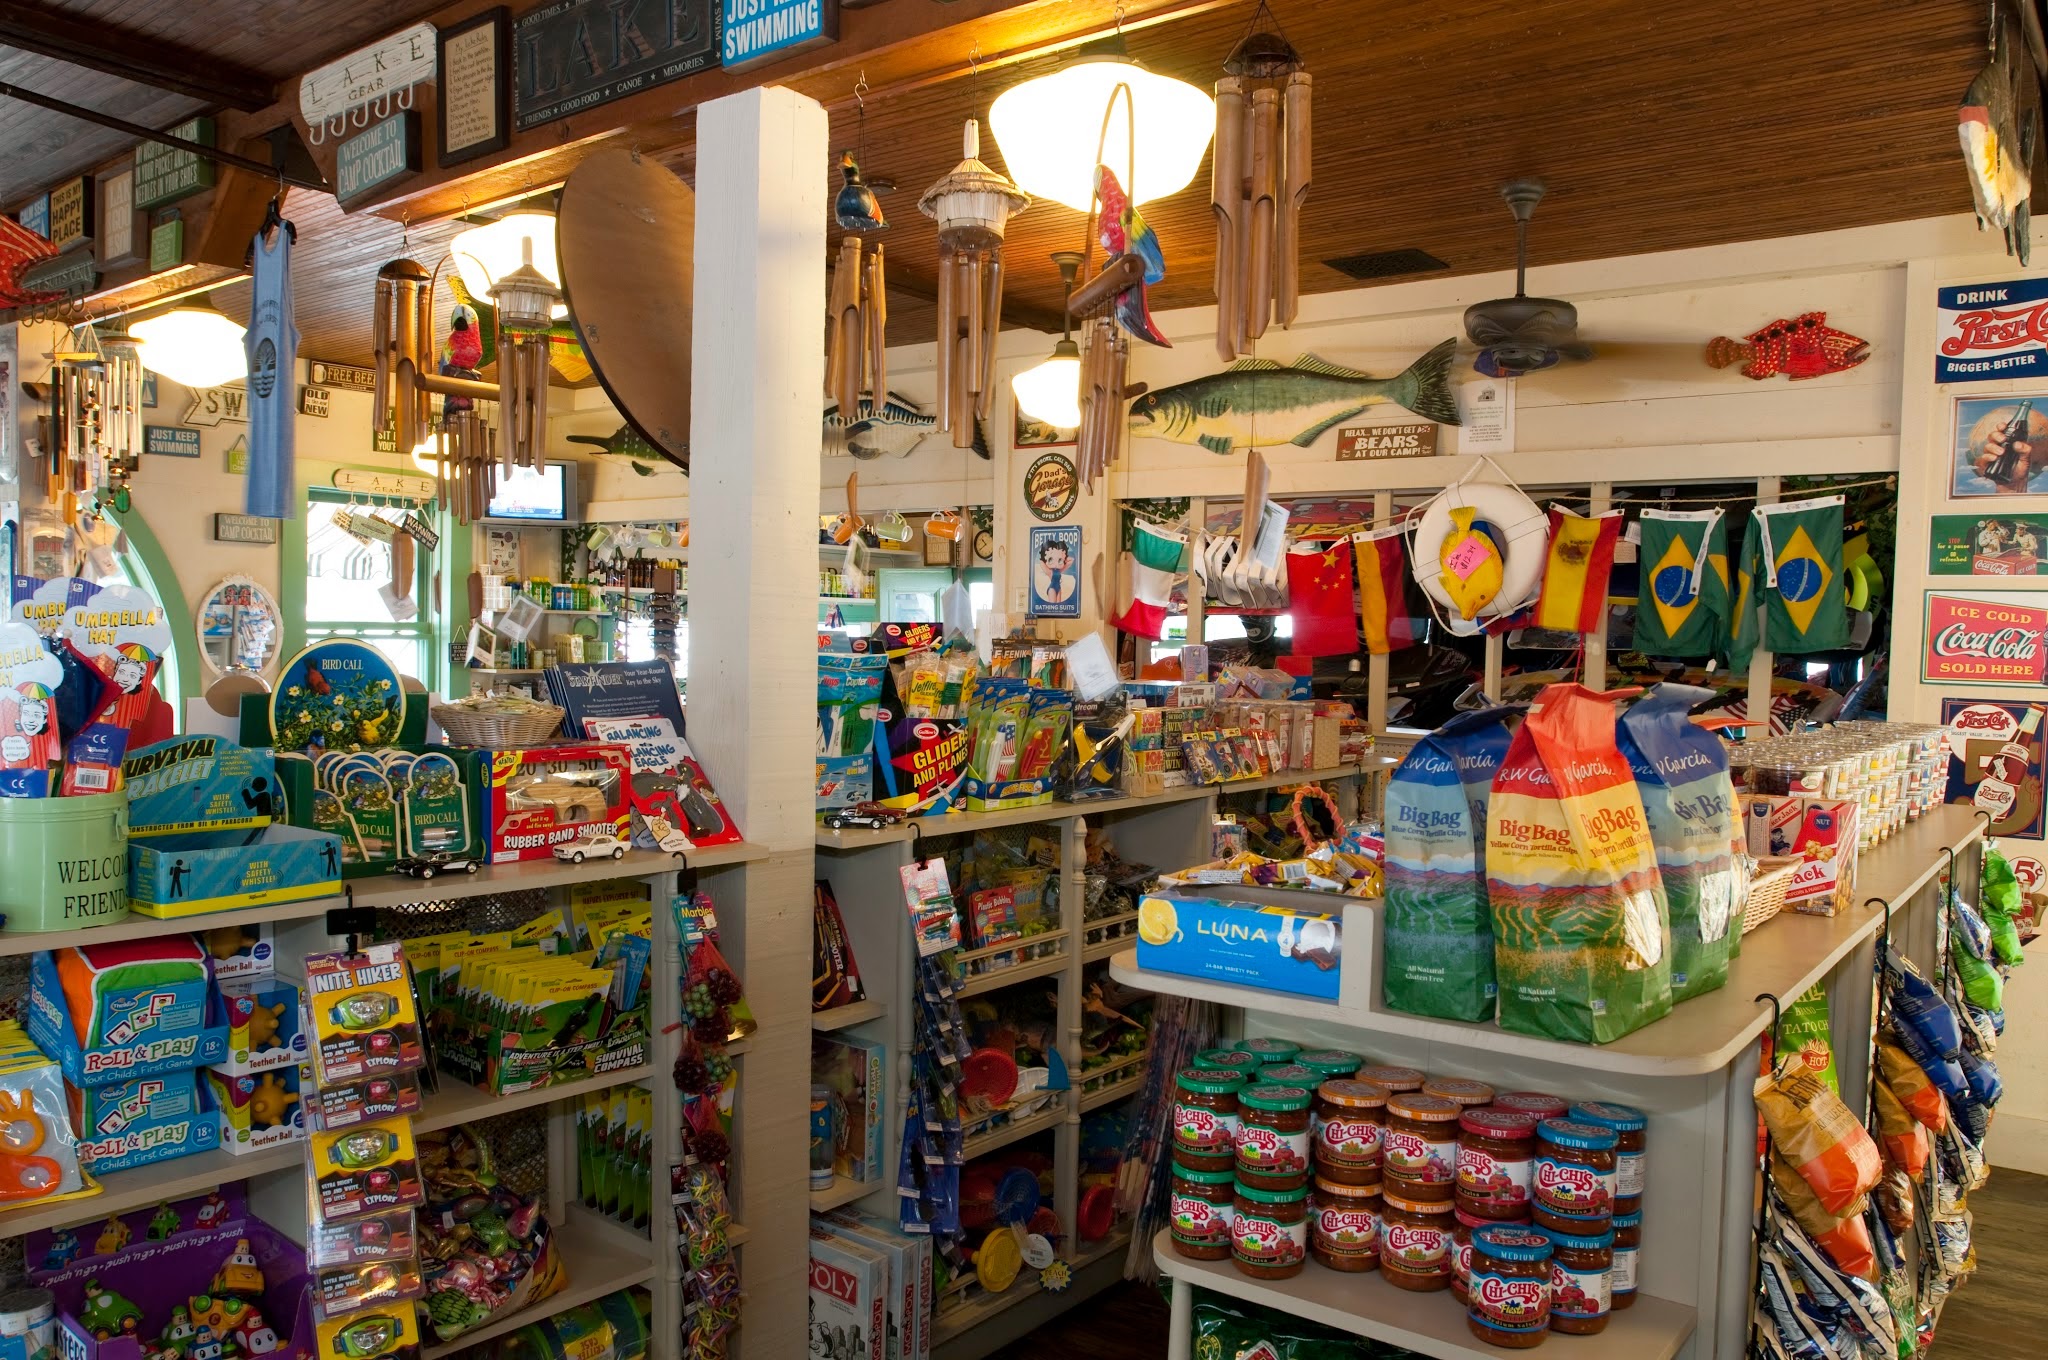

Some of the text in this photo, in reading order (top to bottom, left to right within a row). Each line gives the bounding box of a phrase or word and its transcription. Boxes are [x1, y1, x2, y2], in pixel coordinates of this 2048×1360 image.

[726, 0, 819, 59] SWIMMING
[617, 56, 704, 94] CANOE MEMORIES
[348, 78, 384, 101] GEAR
[525, 91, 600, 125] FRIENDS GOOD FOOD
[343, 120, 397, 162] WELCOME TO
[339, 140, 404, 195] CAMP COCKTAIL
[52, 197, 82, 226] HAPPY
[53, 217, 81, 243] PLACE
[1956, 289, 2008, 305] DRINK
[1947, 355, 2036, 373] BIGGER-BETTER
[306, 389, 328, 401] OLD
[305, 403, 327, 416] NEW
[151, 429, 197, 443] JUST KEEP
[1355, 435, 1419, 450] BEARS
[150, 440, 199, 455] SWIMMING
[1355, 450, 1366, 458] AT
[1369, 449, 1388, 457] OUR
[1391, 448, 1421, 456] CAMP!
[1044, 468, 1066, 479] Dad's
[225, 516, 270, 527] WELCOME TO
[219, 526, 274, 541] CAMP COCKTAIL
[1034, 532, 1078, 549] BETTY BOOP
[1974, 560, 2009, 575] Coca-Cola
[75, 607, 156, 628] UMBRELLA
[1950, 606, 2032, 624] ICE COLD
[88, 629, 117, 645] HAT
[904, 624, 931, 638] GLIDERS
[1935, 622, 2042, 660] Coca-Cola
[322, 659, 364, 670] BIRD CALL
[1939, 662, 2034, 675] SOLD HERE
[911, 679, 937, 695] Jetfire
[607, 726, 663, 741] BALANCING
[913, 728, 968, 769] GLIDERS
[127, 739, 216, 778] URVIVAL
[497, 755, 516, 767] NEATO!
[635, 756, 669, 769] EAGLE
[517, 759, 598, 776] 20 30 50
[913, 747, 968, 788] AND PLANES
[12, 779, 25, 789] CE
[127, 760, 215, 800] RACELET
[206, 807, 237, 815] WHISTLE!
[210, 800, 232, 808] SAFETY
[414, 812, 459, 827] BIRD CALL
[1399, 805, 1461, 828] Big Bag
[1580, 805, 1640, 843] Big Bag
[504, 822, 619, 850] RUBBER BAND SHOOTER
[1408, 828, 1424, 836] Corn
[1425, 829, 1447, 837] Tortilla
[1500, 819, 1571, 845] Big Bag
[1490, 840, 1509, 848] Yellow
[1530, 844, 1557, 852] Tortilla
[1558, 846, 1578, 855] Chips
[246, 867, 272, 877] SAFETY
[249, 861, 269, 869] WITH
[242, 875, 278, 886] WHISTLE!
[978, 896, 1012, 911] Plastic Bubbles
[1198, 919, 1268, 944] LUNA
[411, 951, 434, 959] CLIP-ON
[474, 946, 499, 956] COMPASS
[214, 960, 253, 973] eether Ball
[1206, 963, 1224, 971] 24-BAR
[1225, 966, 1246, 974] VARIETY
[1407, 965, 1416, 973] All
[315, 962, 403, 993] NITE HIKER
[1405, 973, 1445, 983] Gluten Free
[549, 983, 598, 994] CLIP-ON COMPASS
[1518, 987, 1556, 996] All Natural
[205, 1041, 221, 1050] 18+
[249, 1053, 291, 1069] Teether Ball
[595, 1043, 643, 1064] SURVIVAL
[365, 1057, 399, 1068] EXPLORE
[594, 1053, 643, 1073] COMPASS
[1809, 1057, 1827, 1066] HOT
[83, 1059, 193, 1084] Your Child's First Game
[364, 1104, 397, 1115] EXPLORE
[197, 1128, 212, 1137] 18+
[1326, 1122, 1377, 1144] CHI-CHI'S
[1491, 1130, 1507, 1138] HOT
[1616, 1123, 1643, 1131] MEDIUM
[251, 1130, 293, 1147] Teether Ball
[1555, 1136, 1588, 1148] MEDIUM
[101, 1145, 186, 1171] Child's First Game
[1186, 1174, 1204, 1182] MILD
[1460, 1172, 1476, 1184] Fiesta
[1539, 1163, 1593, 1191] CHI-CHI'S
[364, 1195, 398, 1206] EXPLORE
[1552, 1188, 1577, 1201] Fiesta
[1539, 1199, 1564, 1214] Medium
[1233, 1214, 1278, 1242] CHI-CHI'S
[1321, 1210, 1373, 1233] CHI-CHI'S
[1389, 1226, 1441, 1251] CHI-CHI'S
[1567, 1240, 1600, 1249] MEDIUM
[354, 1246, 388, 1256] EXPLORE
[1500, 1251, 1535, 1261] MEDIUM
[1482, 1279, 1540, 1304] CHI-CHI'S
[1501, 1303, 1525, 1315] Fiesta
[904, 1287, 913, 1354] MONOPOLY
[1486, 1315, 1537, 1328] Medium Salsa
[580, 1337, 598, 1350] CASE
